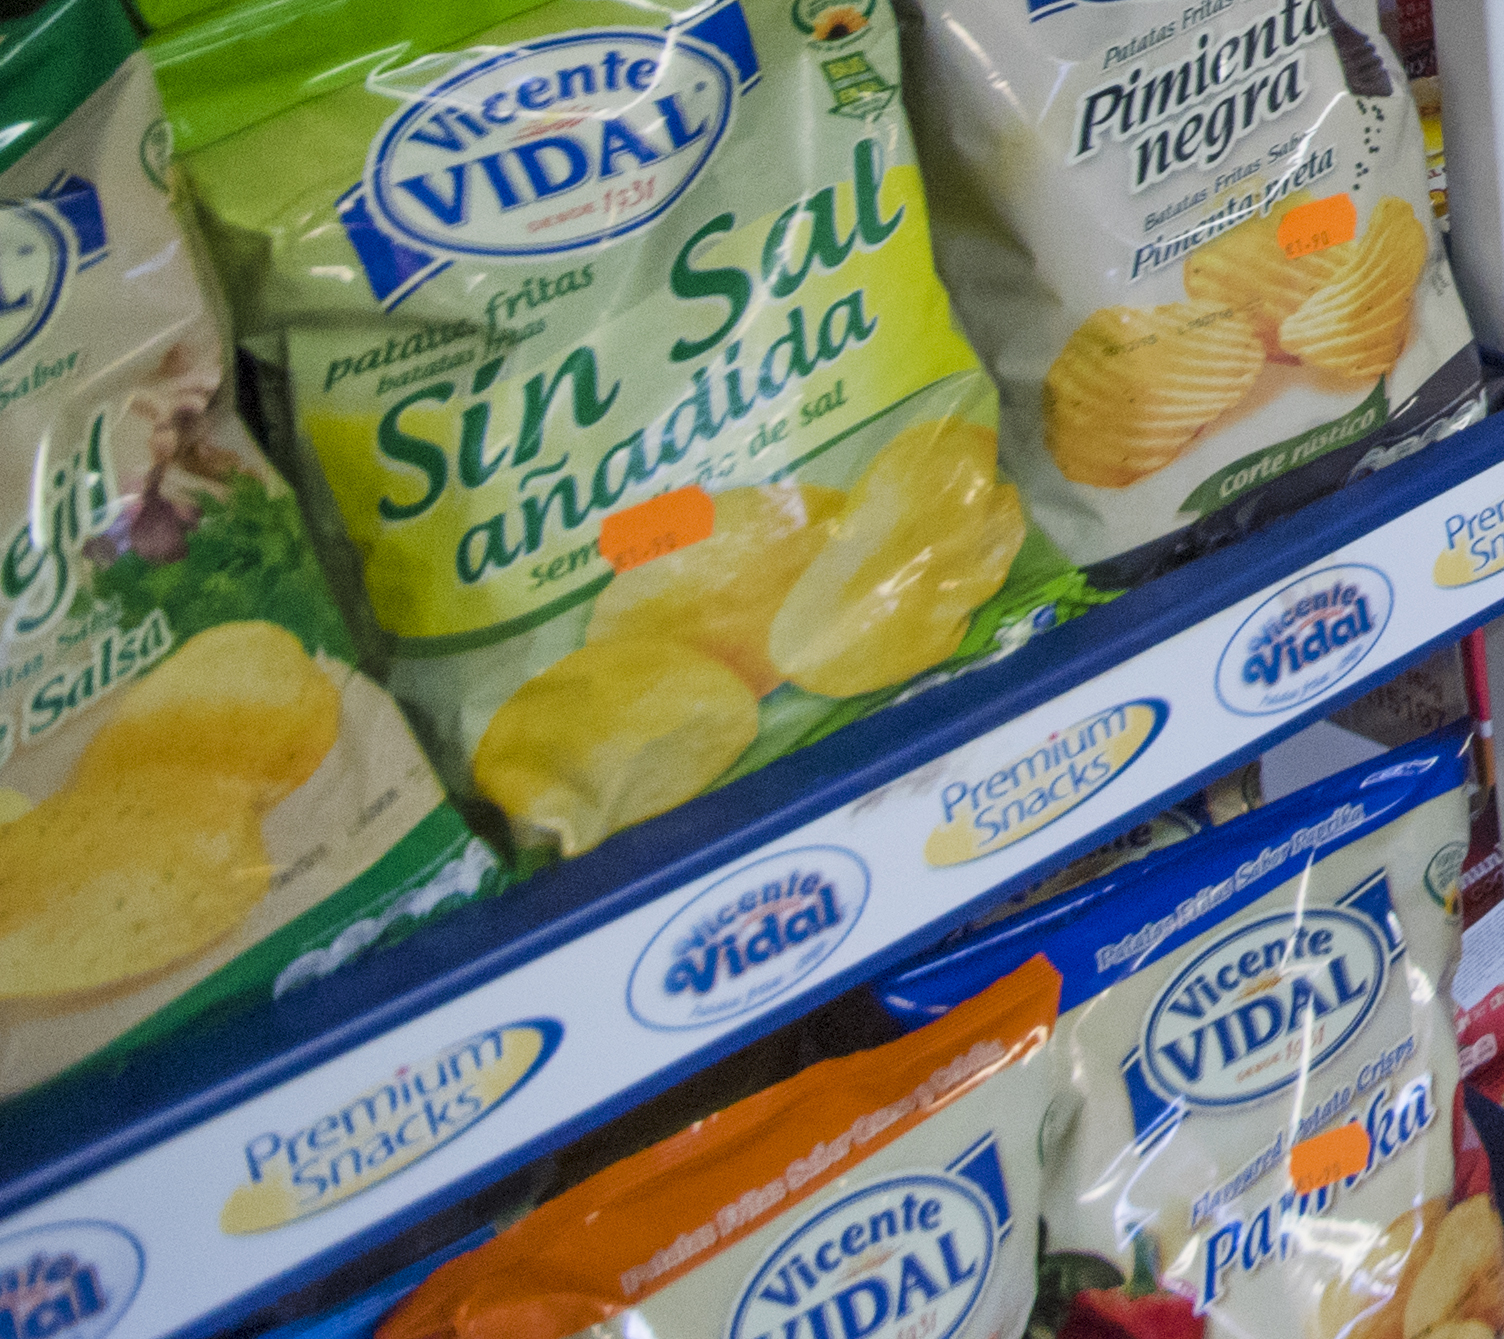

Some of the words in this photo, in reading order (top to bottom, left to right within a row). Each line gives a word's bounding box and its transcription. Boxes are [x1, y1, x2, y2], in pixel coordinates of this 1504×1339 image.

[1101, 20, 1178, 72] Patatas
[397, 89, 707, 228] VIDAL
[1131, 61, 1305, 189] negra
[1130, 215, 1258, 283] Pimenta
[1261, 147, 1336, 225] preta
[323, 318, 477, 392] patatas
[484, 262, 595, 327] fritas
[376, 346, 622, 522] Sin
[668, 135, 907, 364] Sal
[456, 288, 880, 585] añadida
[1218, 452, 1285, 498] corte
[1288, 405, 1378, 468] rústico
[529, 536, 600, 591] sem
[30, 607, 167, 735] Salsa
[663, 883, 845, 1001] Vidal
[1157, 954, 1368, 1083] VIDAL
[759, 1192, 944, 1309] Vicente
